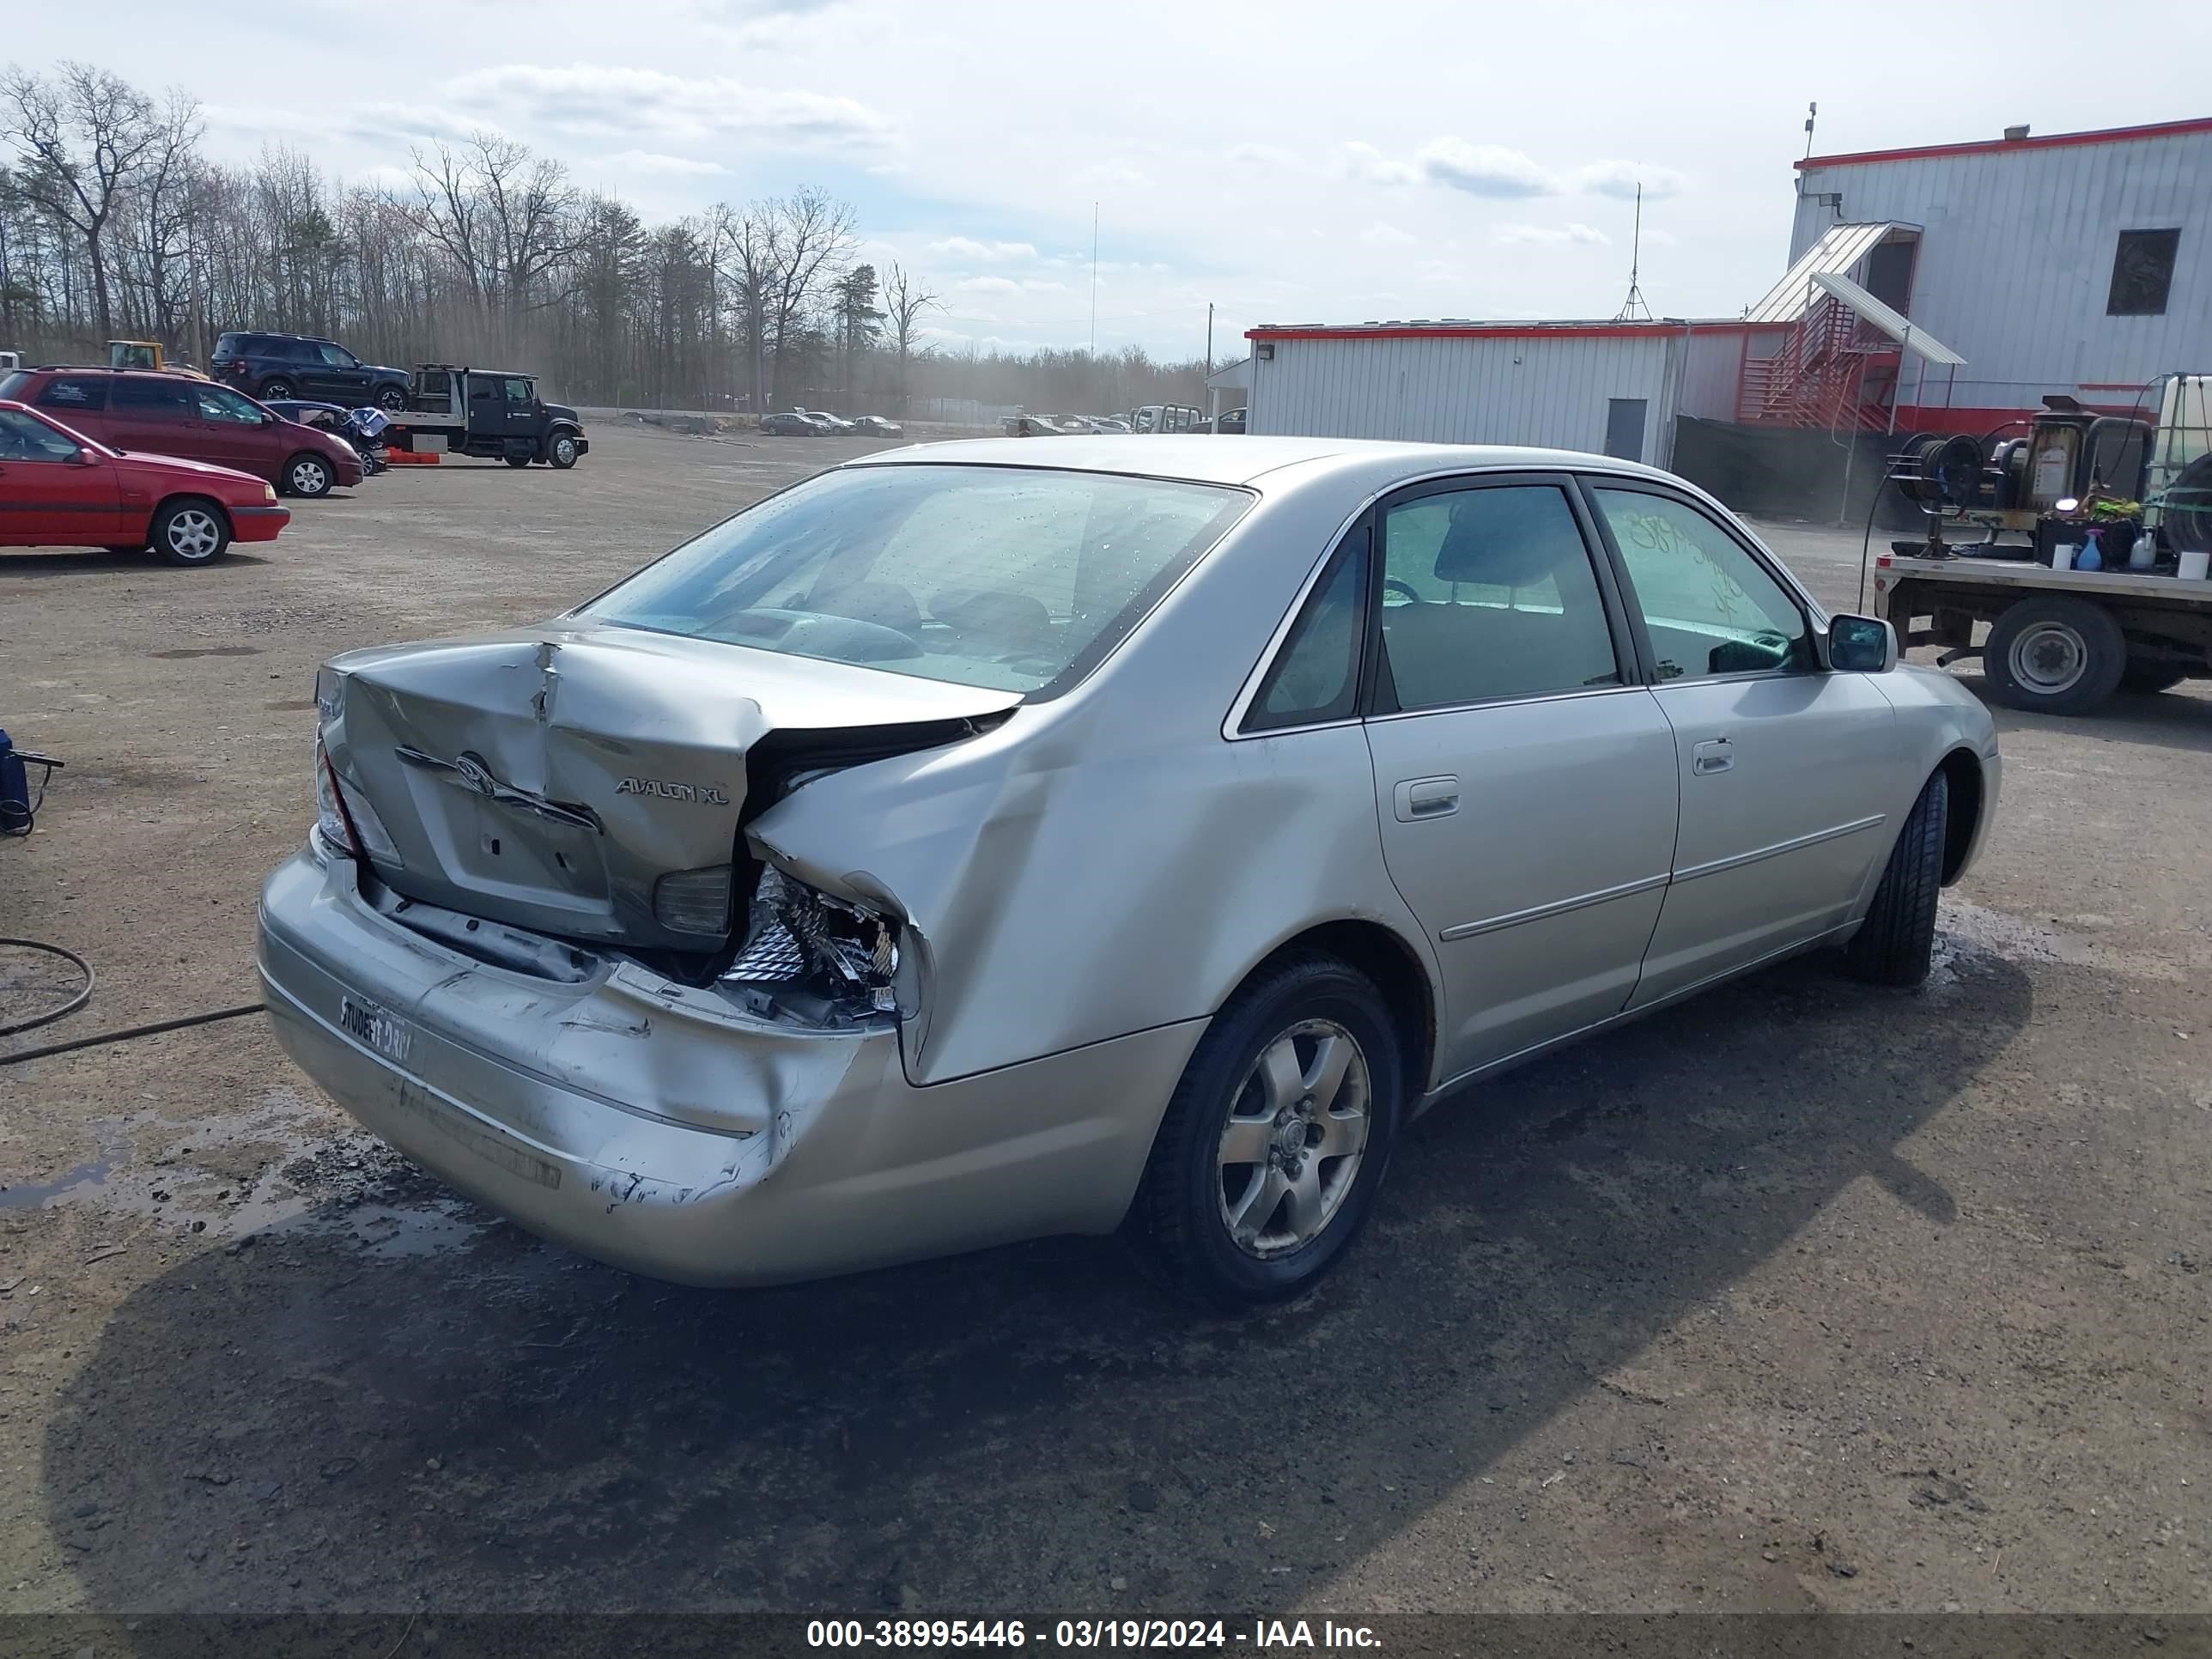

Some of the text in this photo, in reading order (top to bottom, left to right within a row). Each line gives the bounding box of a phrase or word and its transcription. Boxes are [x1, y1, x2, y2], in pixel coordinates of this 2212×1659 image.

[616, 777, 729, 805] AVALON XL
[340, 995, 383, 1048] STUDENT
